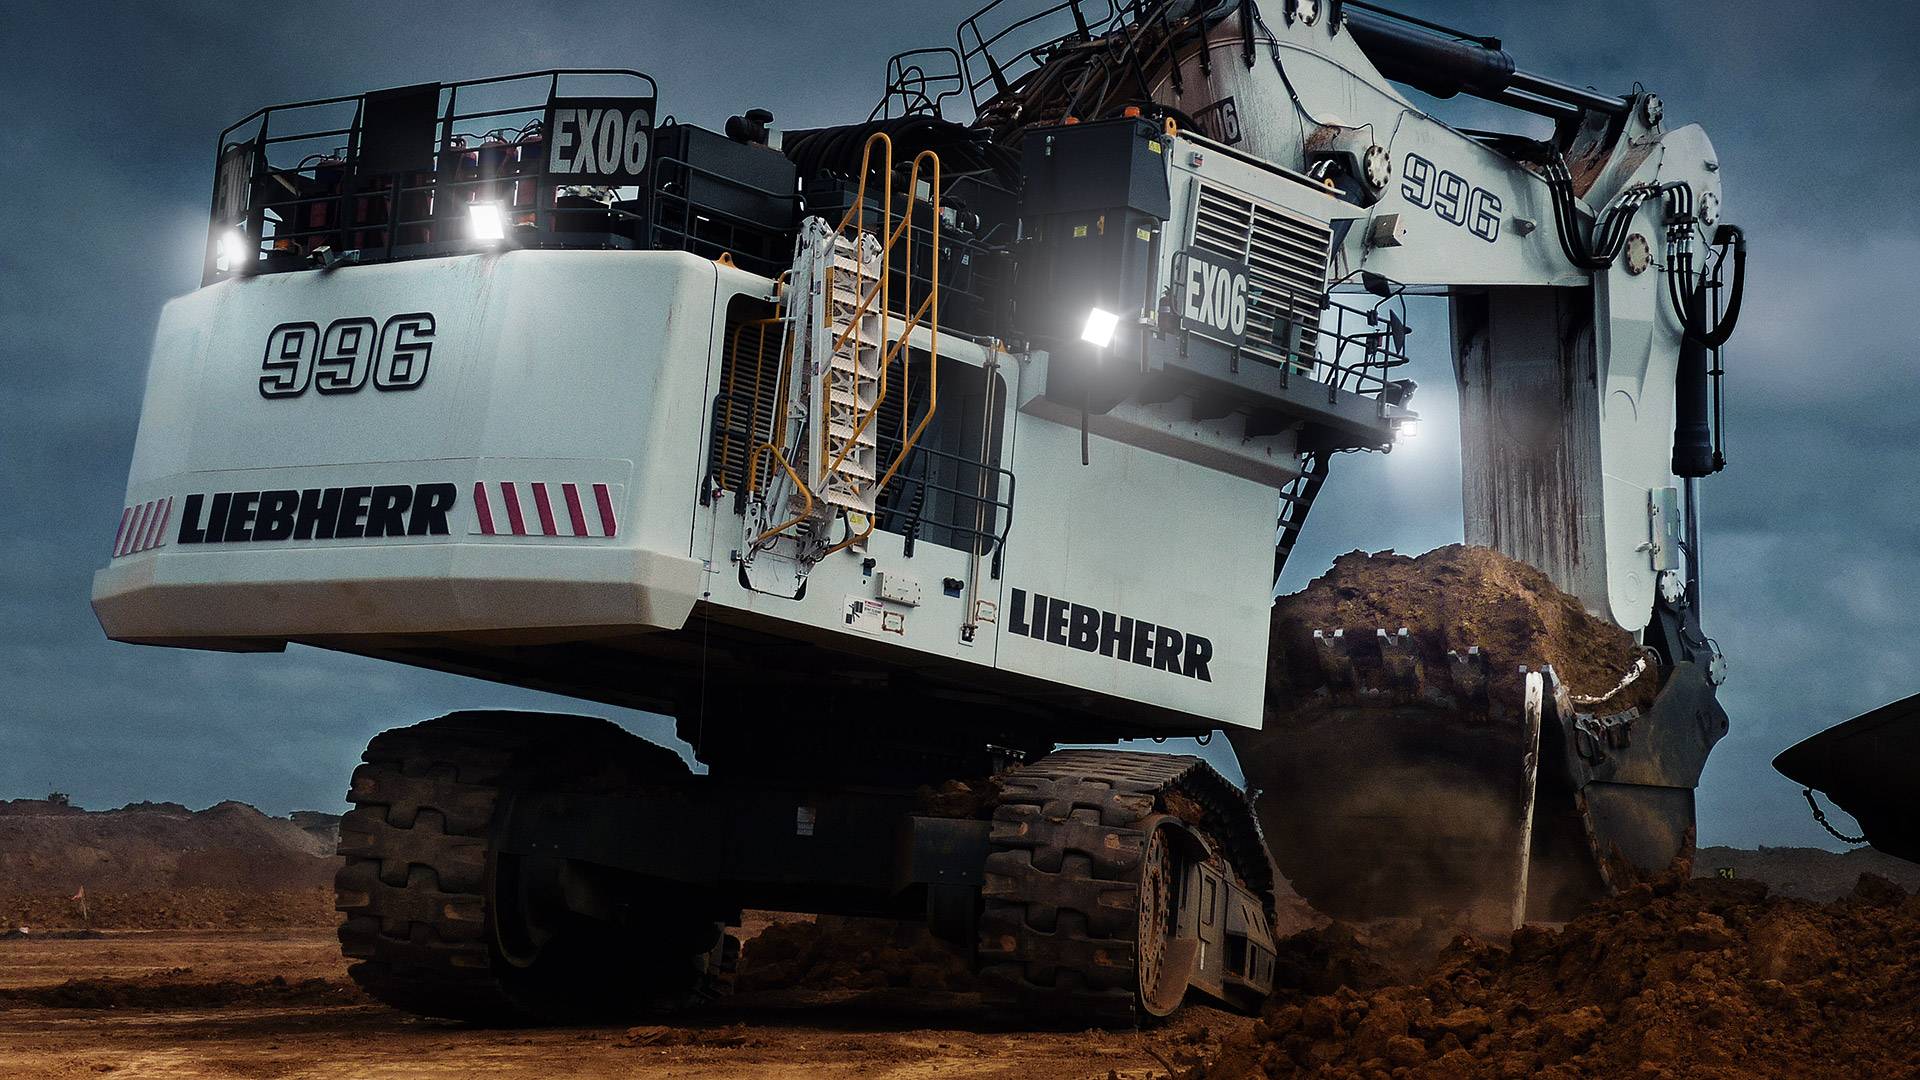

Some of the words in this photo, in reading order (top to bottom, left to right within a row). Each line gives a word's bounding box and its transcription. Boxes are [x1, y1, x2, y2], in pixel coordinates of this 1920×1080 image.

[550, 108, 649, 175] EX06
[1401, 152, 1502, 242] 996
[1185, 257, 1247, 335] EX06
[259, 312, 436, 398] 996
[178, 482, 457, 545] LIEBHERR
[1009, 588, 1212, 682] LIEBHERR
